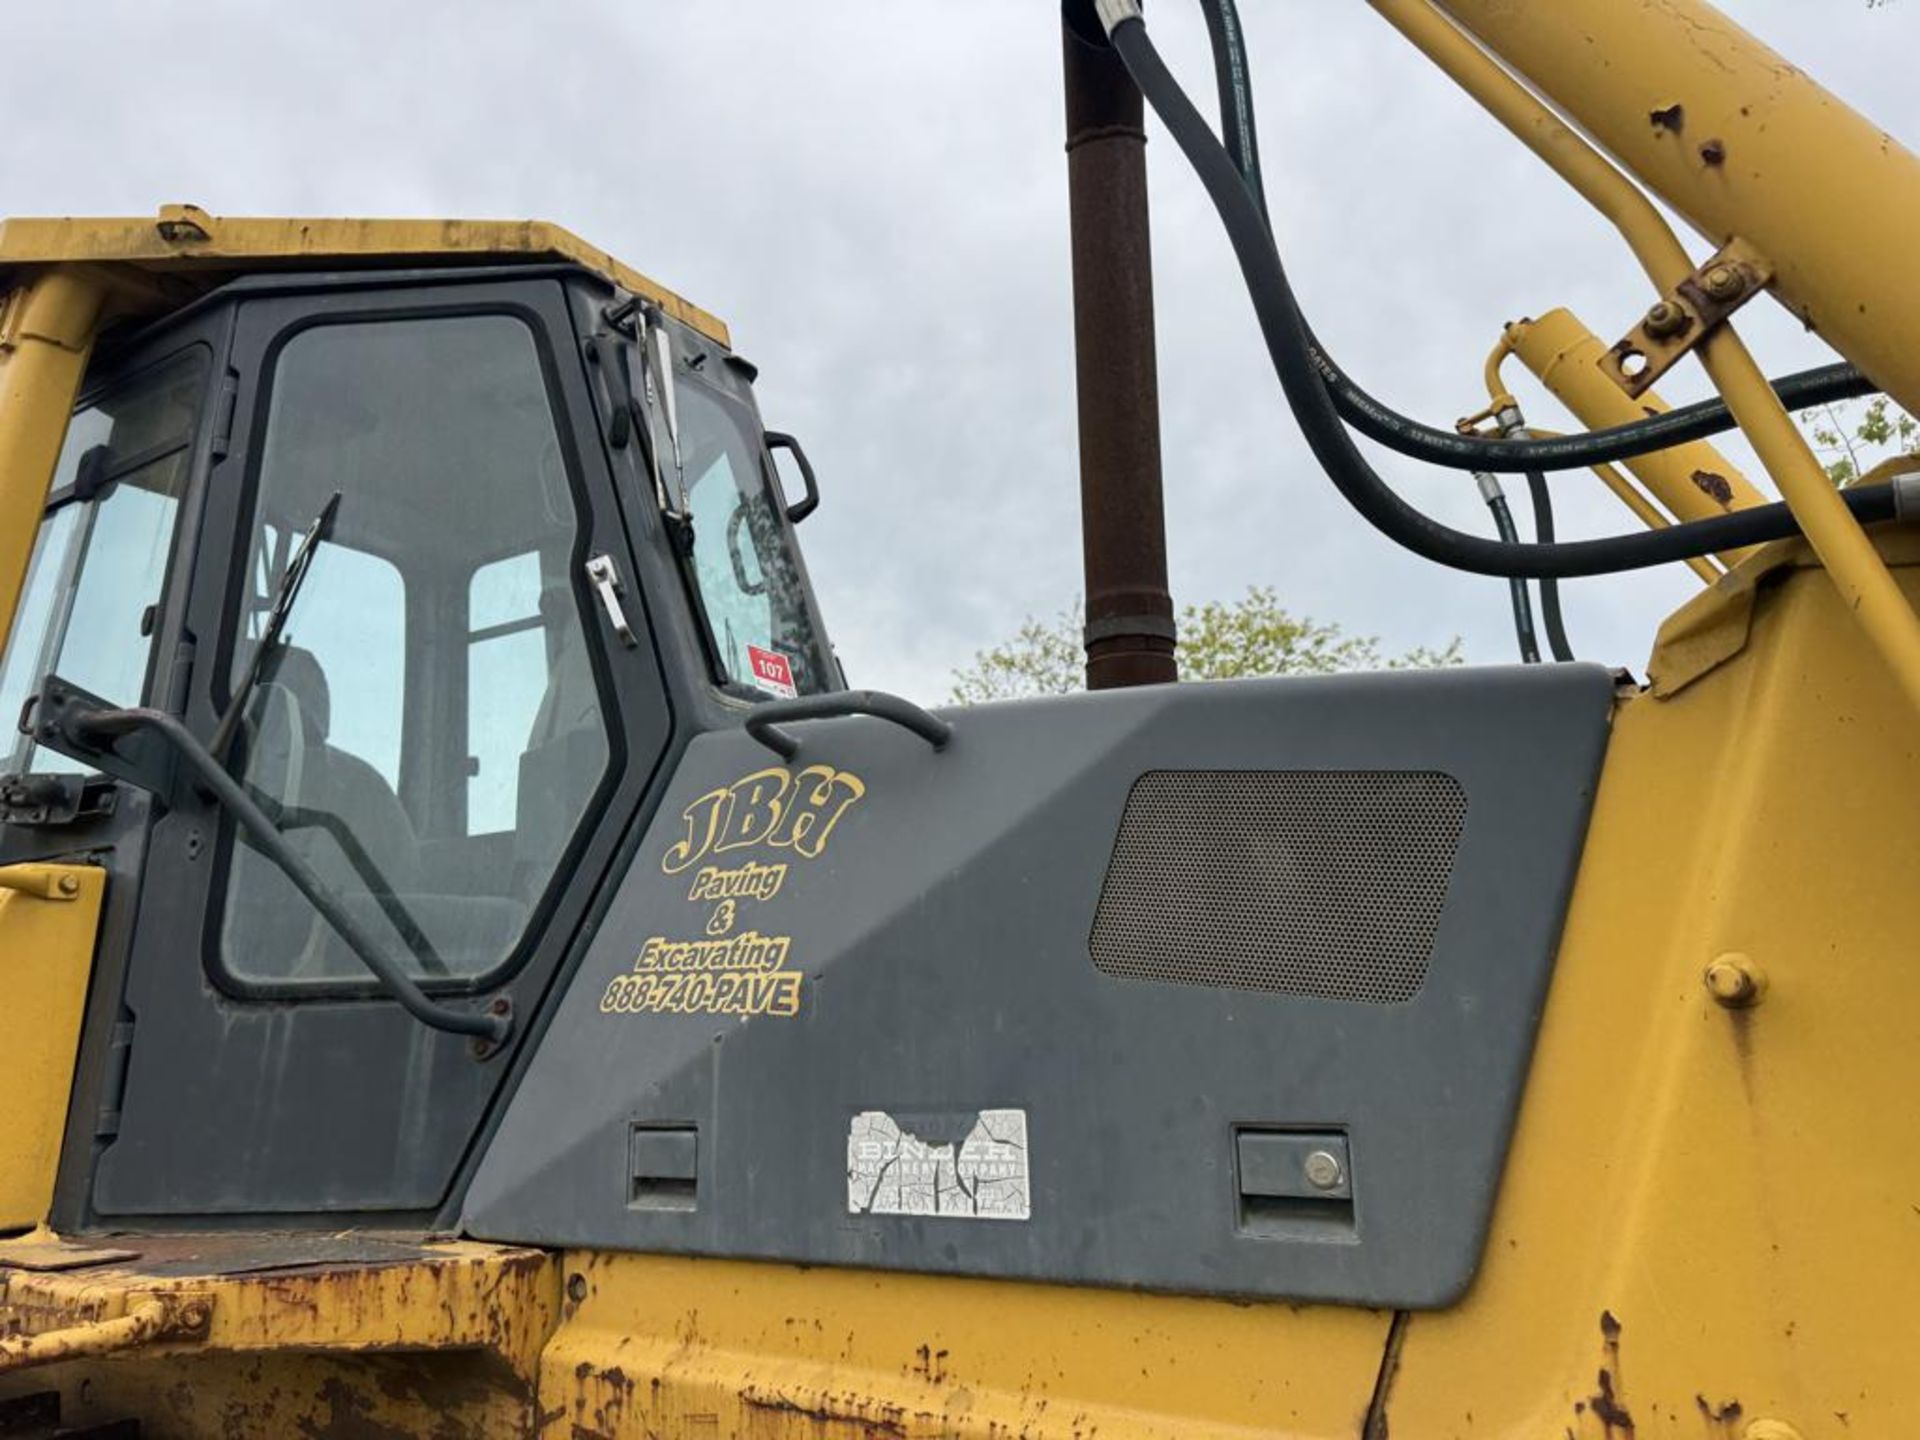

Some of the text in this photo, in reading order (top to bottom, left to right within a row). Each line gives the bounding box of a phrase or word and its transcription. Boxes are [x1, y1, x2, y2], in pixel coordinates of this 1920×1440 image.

[759, 659, 783, 680] 107
[662, 764, 866, 875] JBH
[688, 861, 788, 900] Paving
[706, 899, 736, 934] &
[634, 931, 791, 975] Excavating
[600, 971, 803, 1016] 888-740-PAVE
